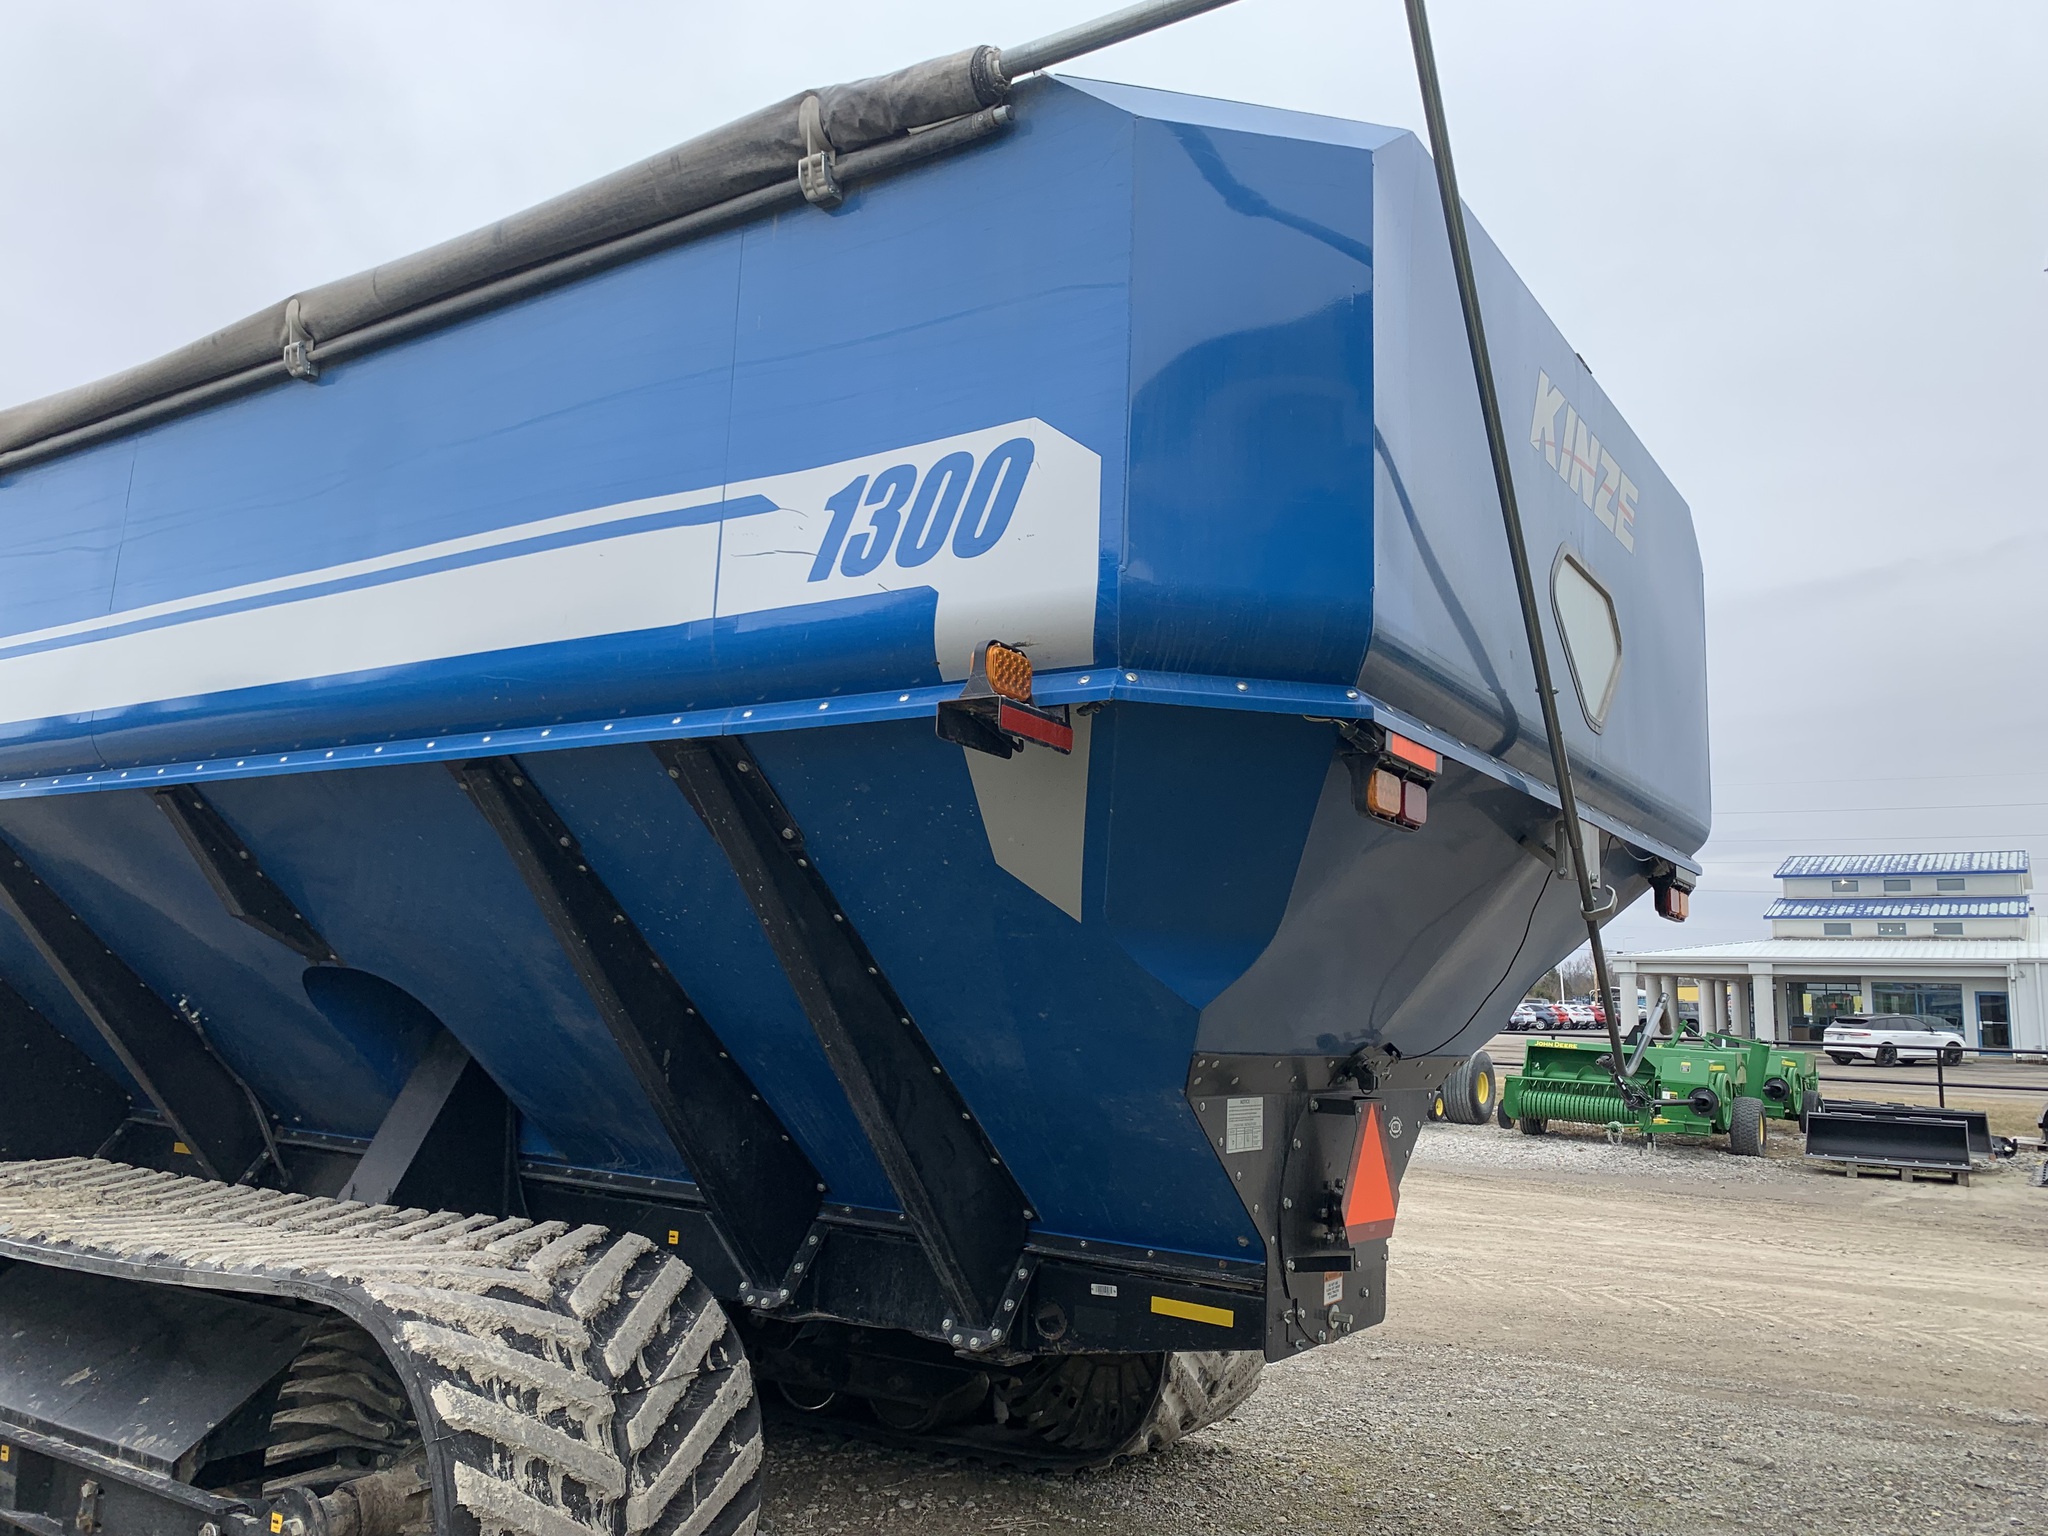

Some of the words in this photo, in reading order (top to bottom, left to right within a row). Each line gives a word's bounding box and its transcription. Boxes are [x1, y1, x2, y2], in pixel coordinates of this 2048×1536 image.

[807, 437, 1035, 583] 1300
[1530, 367, 1639, 554] KINZE
[1534, 1040, 1554, 1048] JOHN
[1554, 1041, 1578, 1049] DEERE
